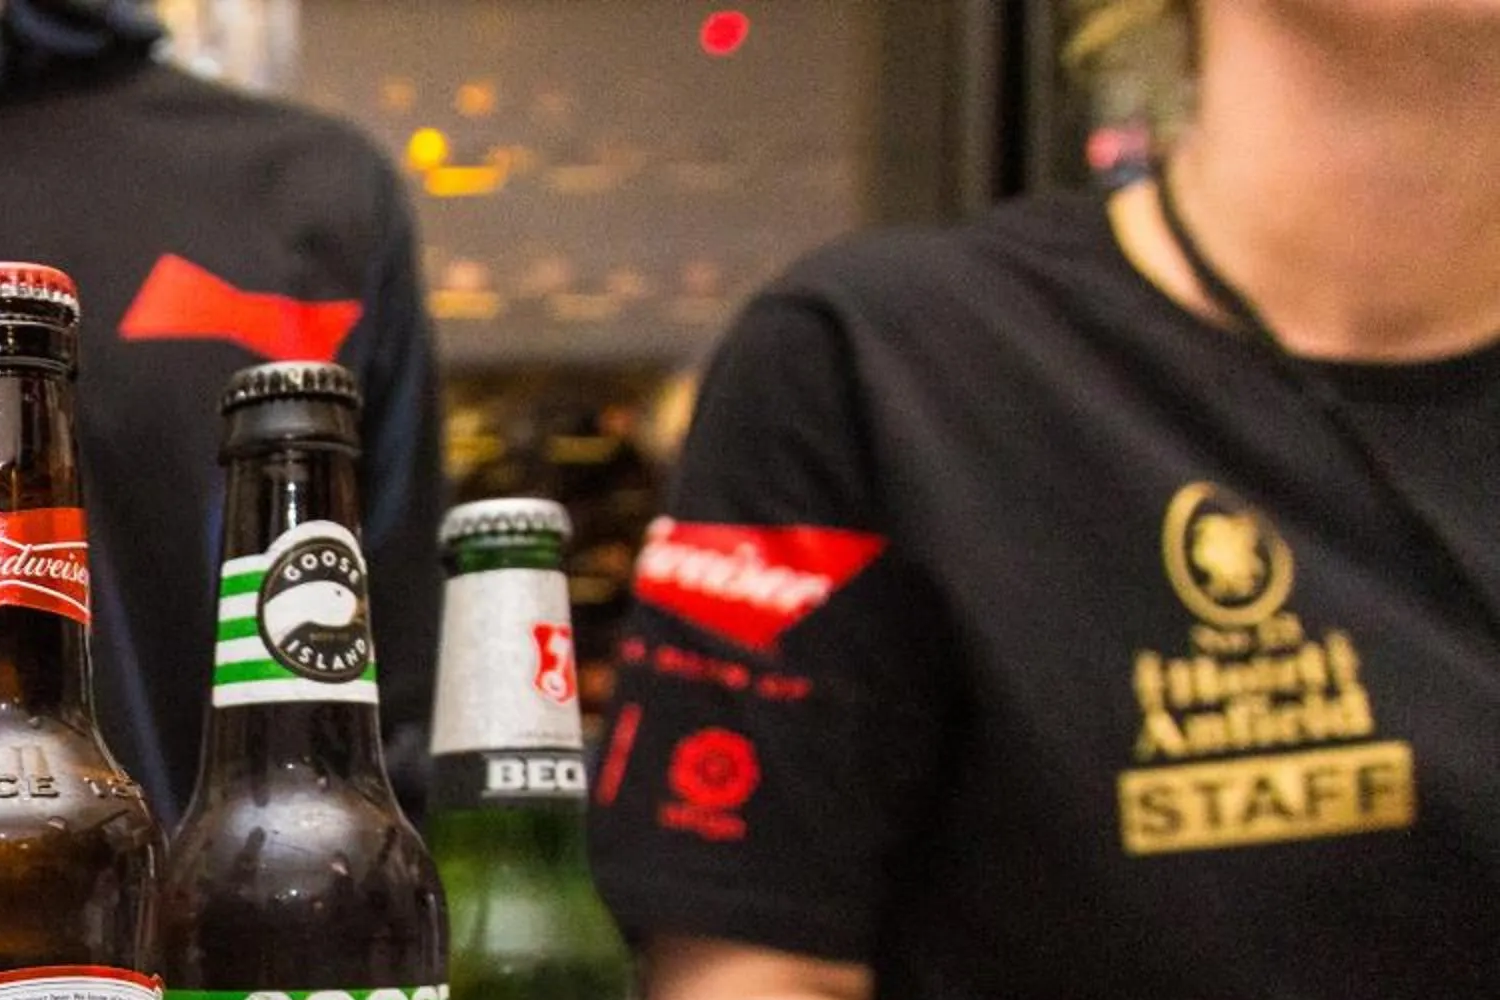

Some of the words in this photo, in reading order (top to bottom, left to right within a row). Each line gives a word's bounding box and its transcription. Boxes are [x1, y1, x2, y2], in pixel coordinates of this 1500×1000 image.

[283, 550, 360, 584] GOOSE
[285, 638, 366, 671] ISLAND
[1136, 761, 1394, 837] STAFF
